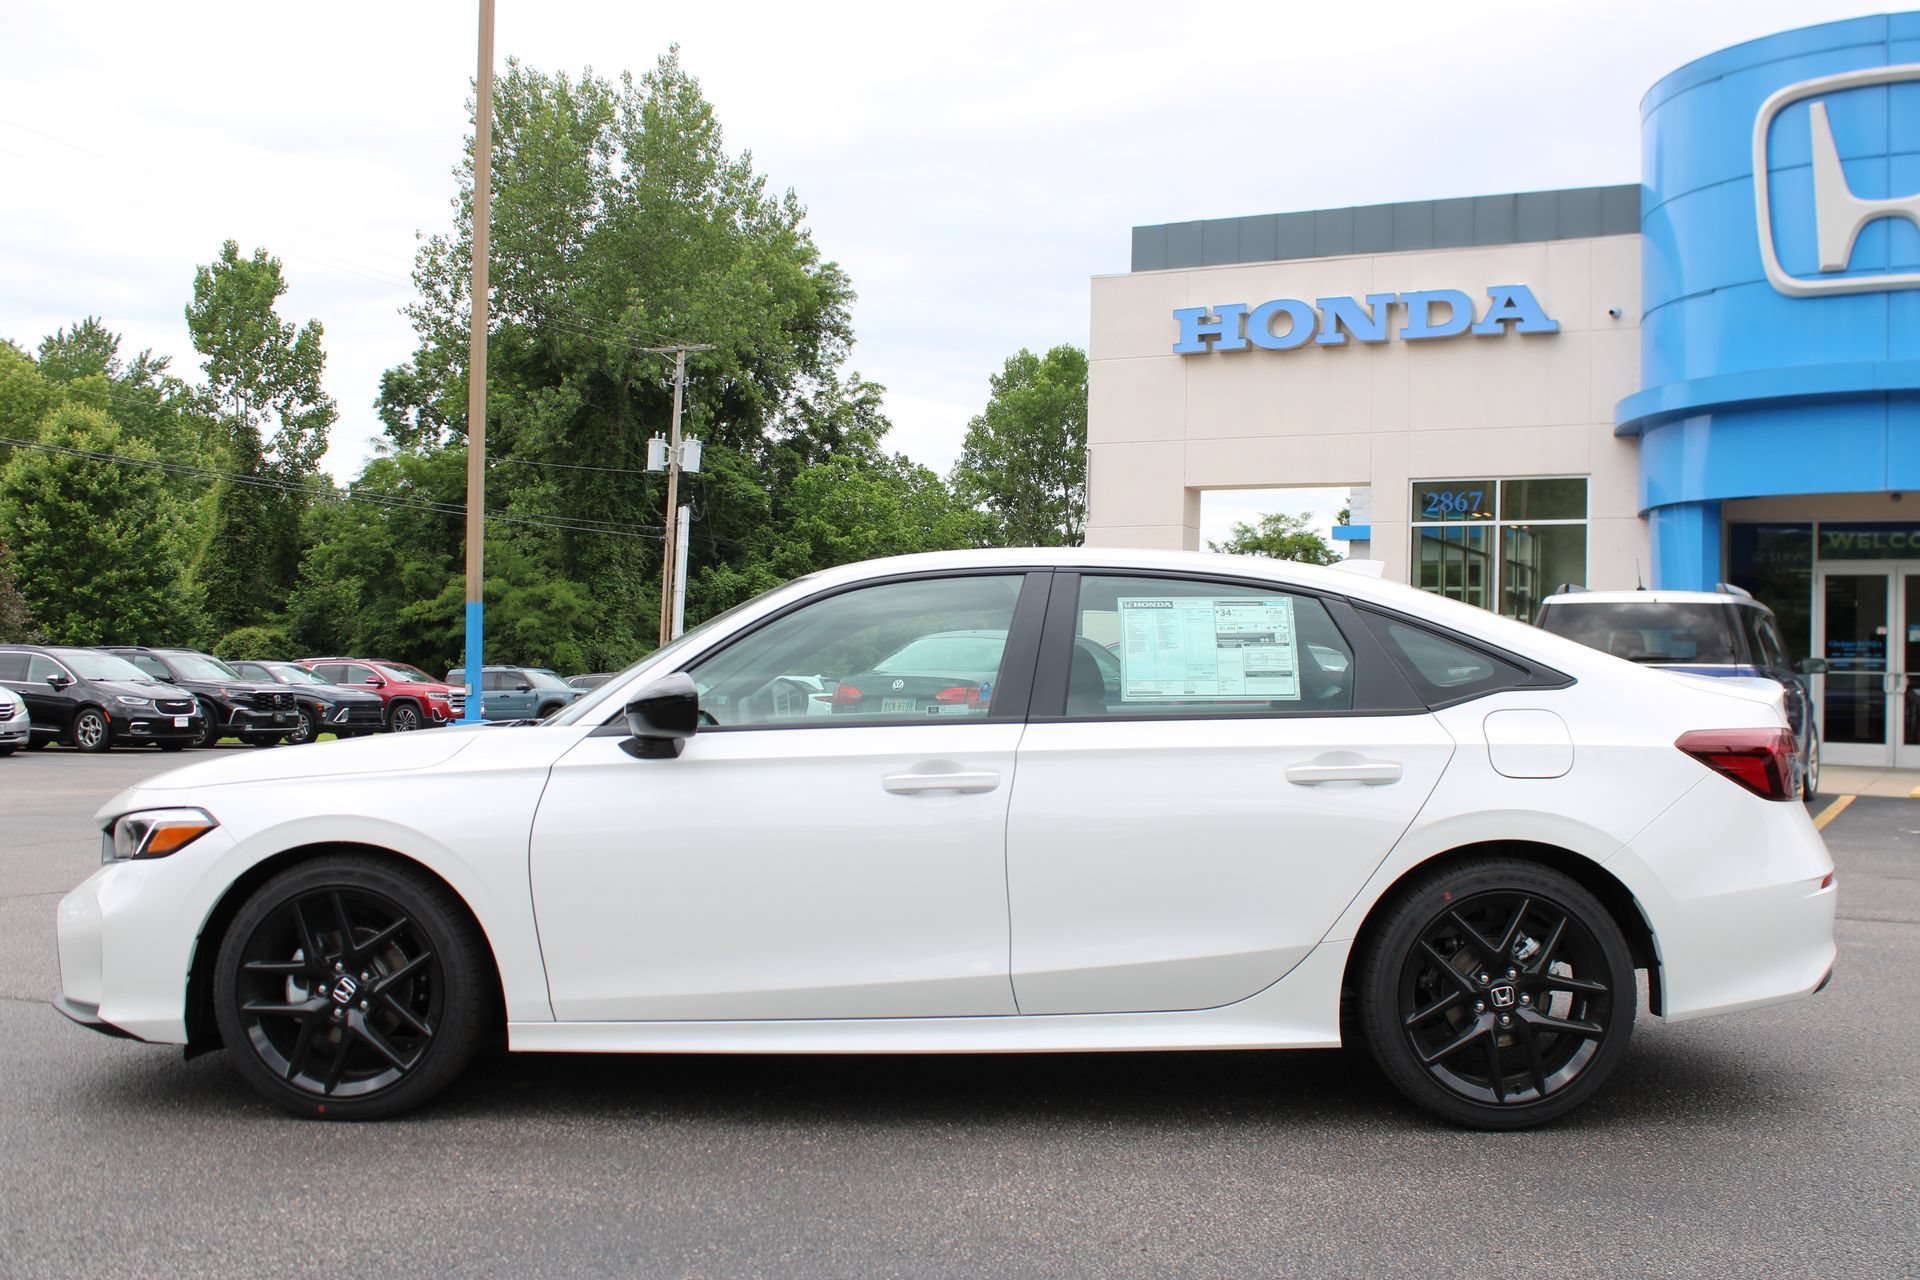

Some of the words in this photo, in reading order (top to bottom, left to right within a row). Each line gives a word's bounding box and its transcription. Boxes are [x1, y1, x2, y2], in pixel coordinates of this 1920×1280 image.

[1172, 283, 1560, 355] HONDA
[1426, 491, 1483, 512] 2867
[1220, 609, 1232, 617] 34
